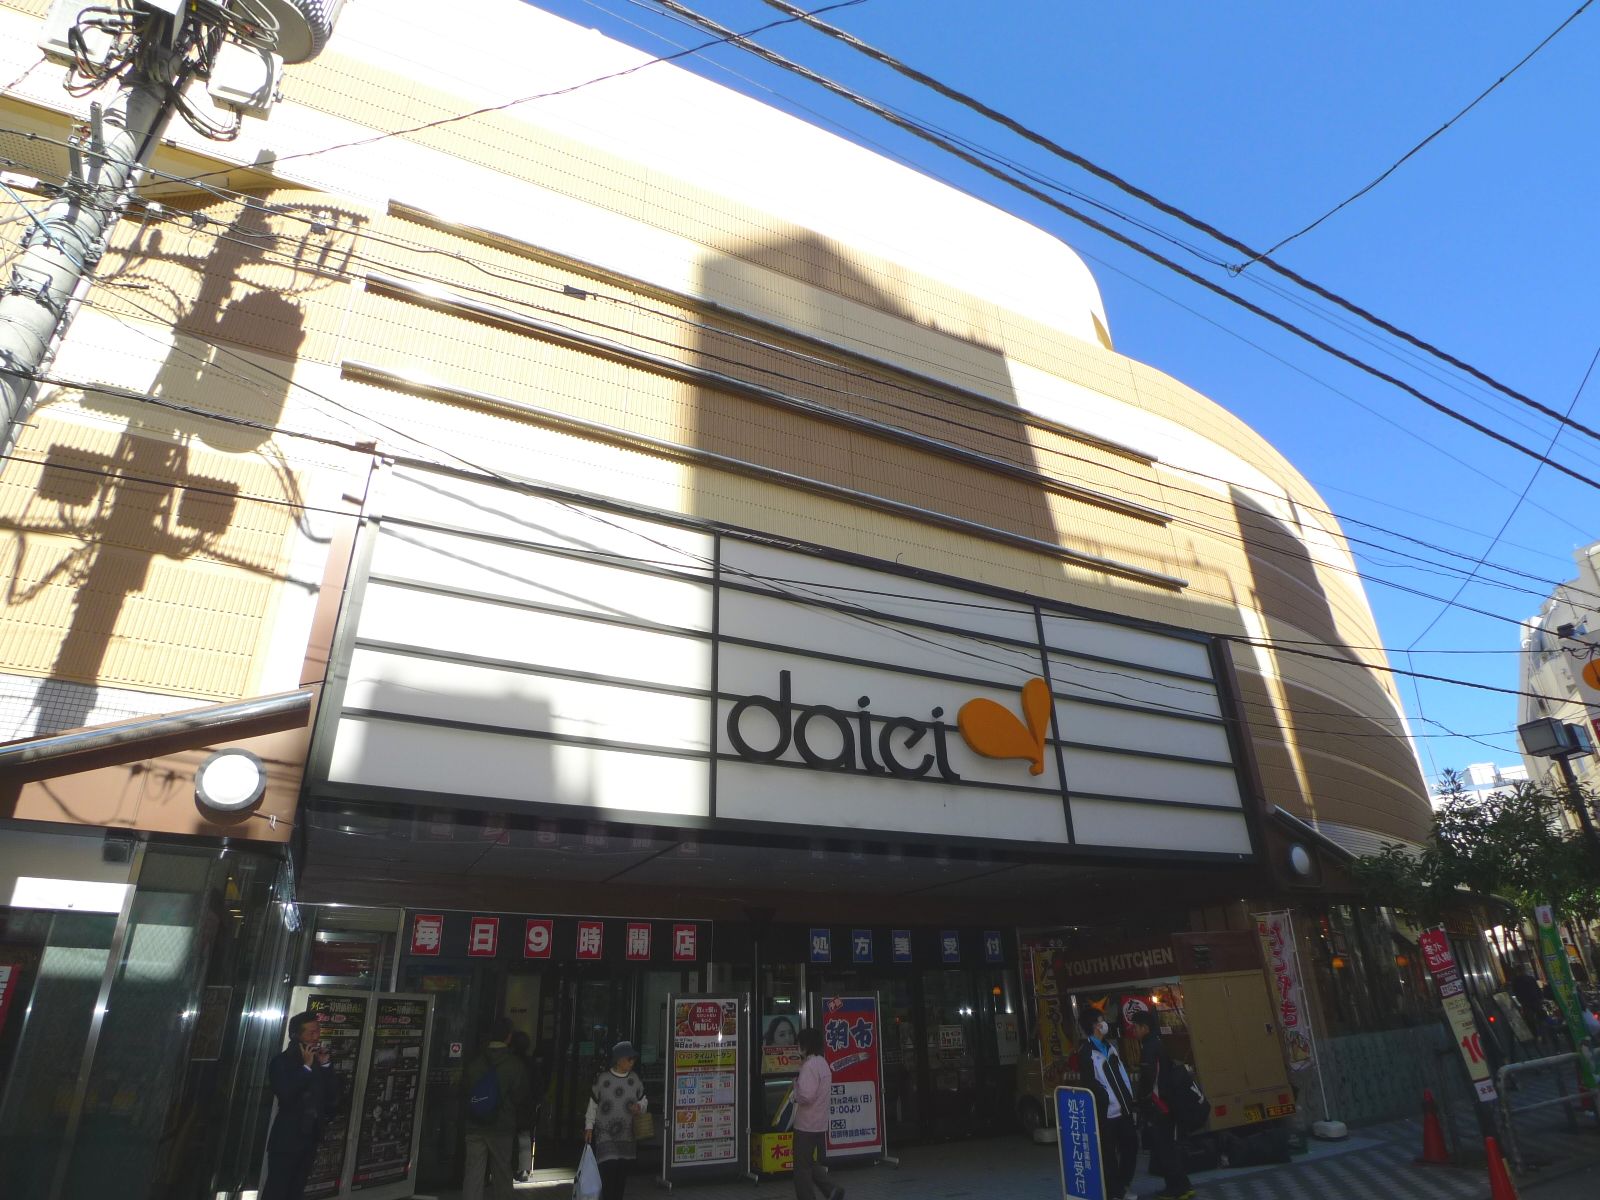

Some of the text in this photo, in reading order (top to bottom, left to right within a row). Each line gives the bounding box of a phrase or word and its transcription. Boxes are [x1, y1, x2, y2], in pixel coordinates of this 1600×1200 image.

[727, 670, 960, 780] daiei
[415, 919, 694, 956] 毎日9時開店
[1065, 947, 1174, 977] YOUTH KITCHEN
[825, 1017, 873, 1052] 朝市
[1068, 1099, 1086, 1194] 処方せん受付
